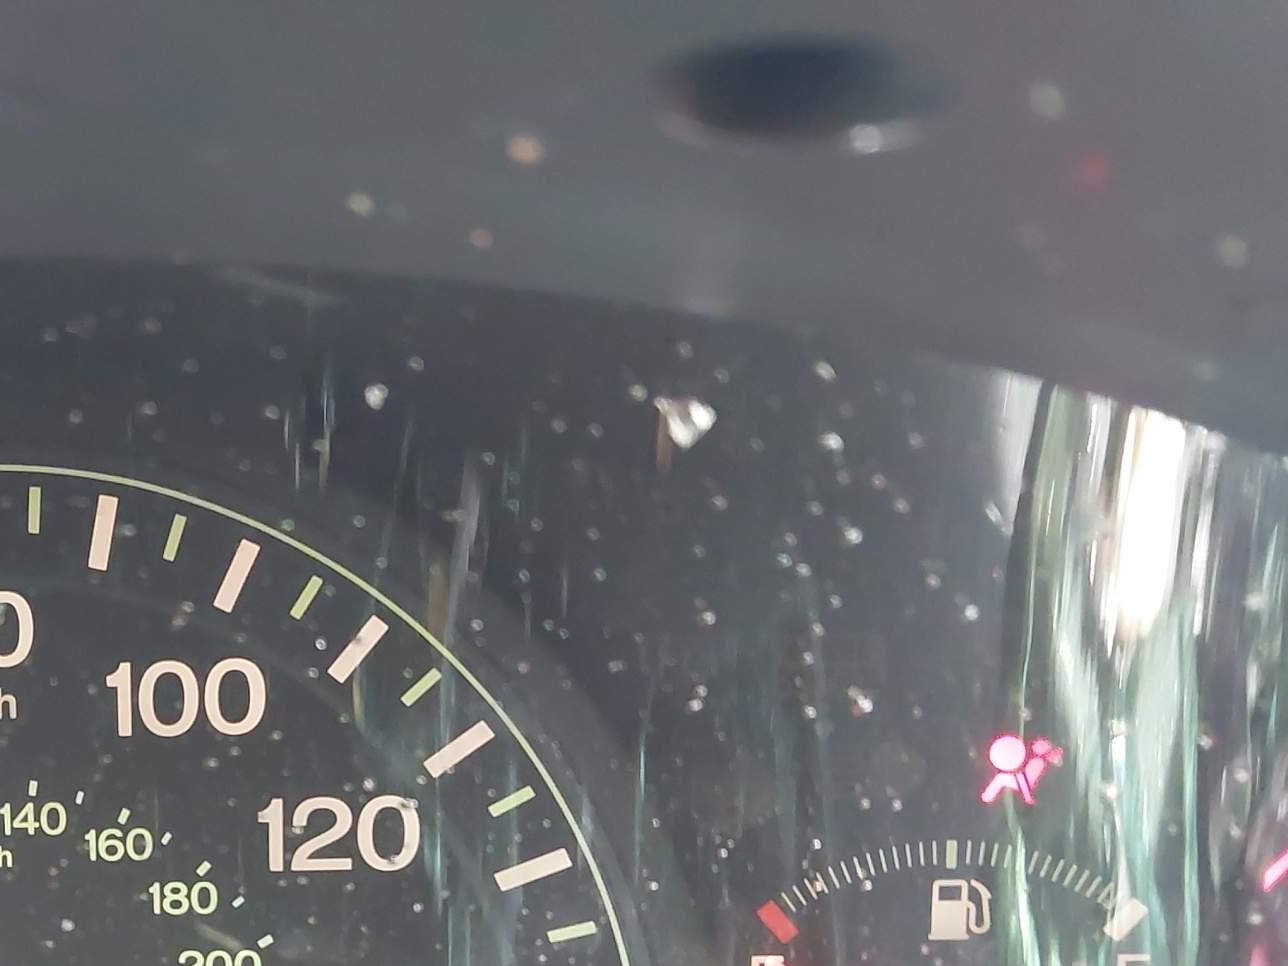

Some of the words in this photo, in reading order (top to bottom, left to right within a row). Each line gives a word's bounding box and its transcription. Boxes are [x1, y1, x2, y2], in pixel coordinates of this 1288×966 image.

[106, 658, 267, 737] 100
[0, 802, 67, 836] 140
[258, 795, 421, 872] 120
[85, 827, 153, 861] 160
[149, 881, 217, 915] 180
